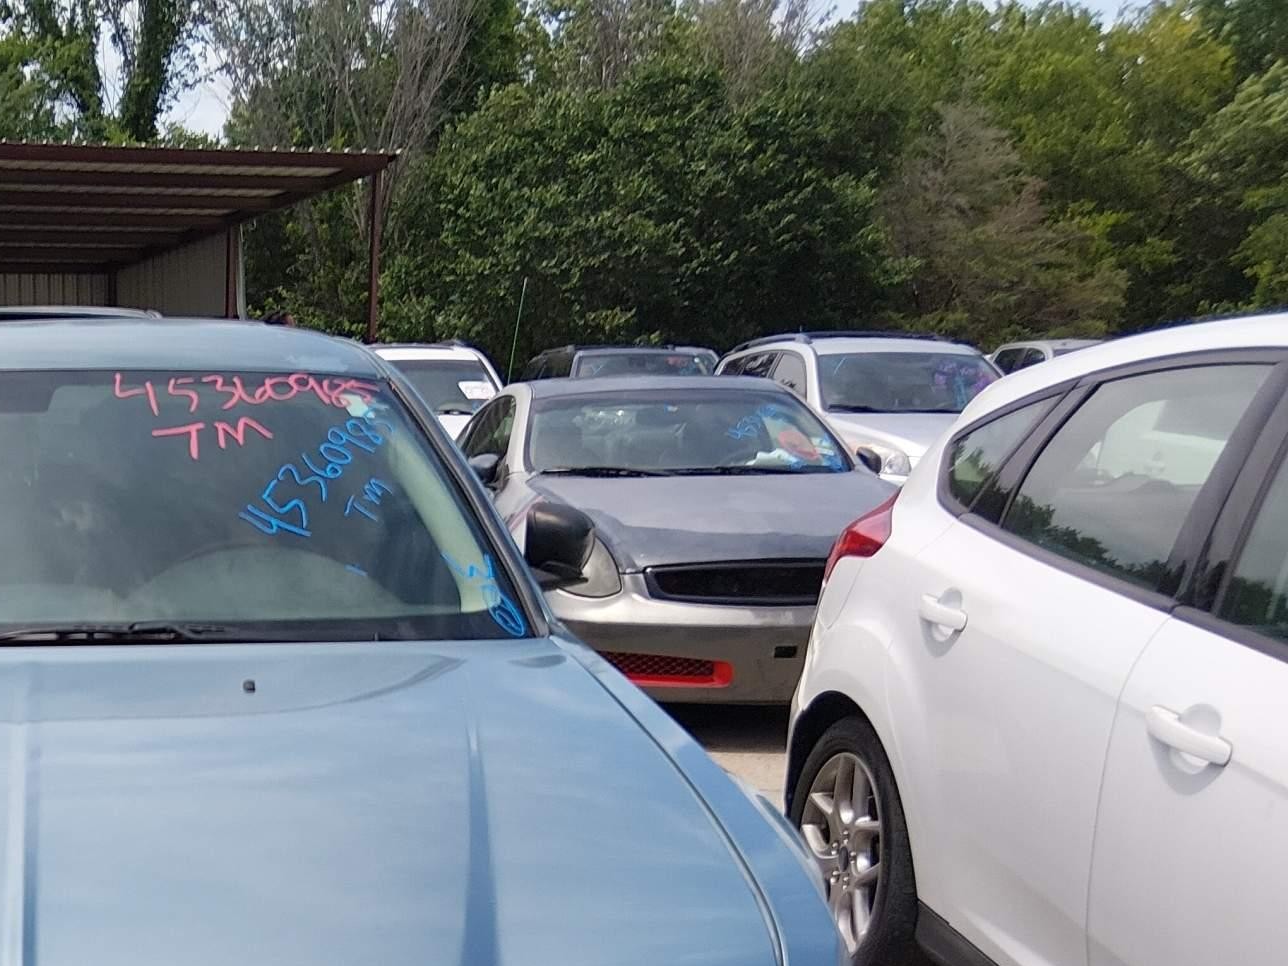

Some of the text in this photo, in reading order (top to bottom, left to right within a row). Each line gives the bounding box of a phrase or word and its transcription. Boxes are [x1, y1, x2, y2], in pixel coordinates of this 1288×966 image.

[114, 372, 381, 417] 45360985
[151, 416, 274, 460] TM
[238, 401, 395, 537] 45360985
